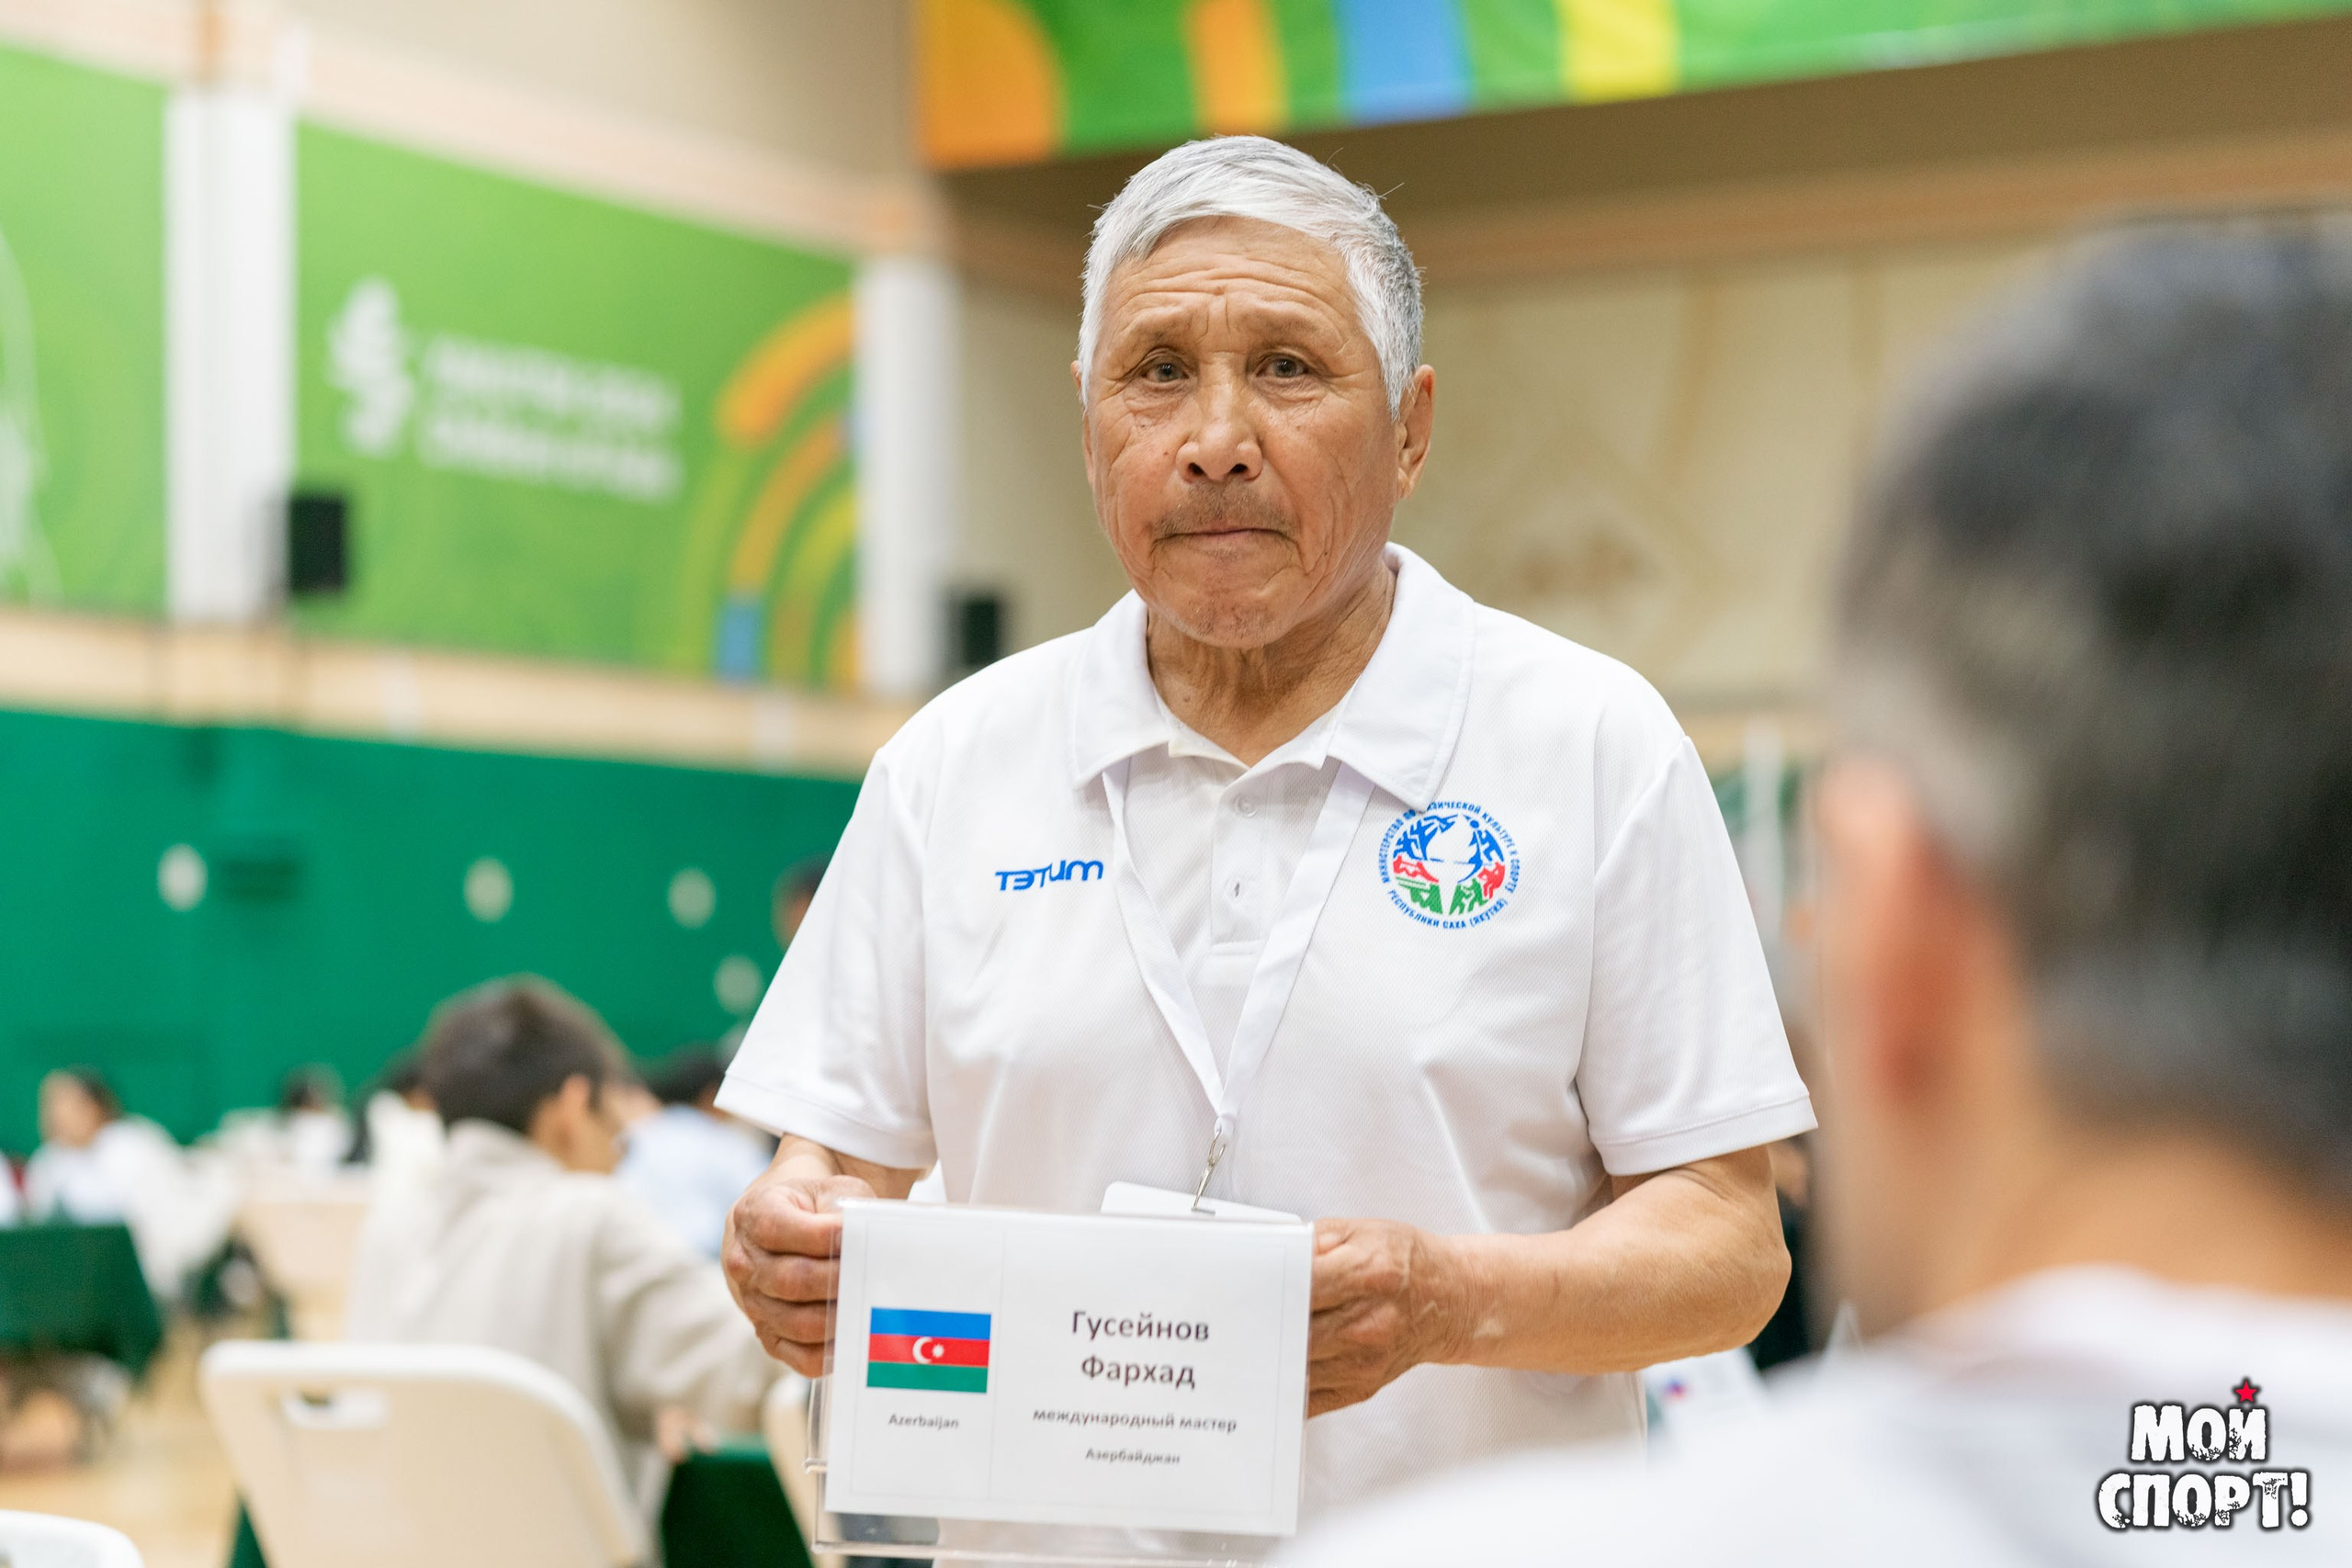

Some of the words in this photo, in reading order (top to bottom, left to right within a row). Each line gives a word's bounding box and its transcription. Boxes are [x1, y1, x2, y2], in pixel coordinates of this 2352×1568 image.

[1387, 889, 1440, 928] РЕСПУБЛИКИ
[1442, 919, 1466, 930] САХА
[1470, 897, 1509, 928] (ЯКУТИЯ)
[1071, 1310, 1210, 1342] Гусейнов
[1080, 1355, 1196, 1390] Фархад
[888, 1413, 959, 1430] Azerbaijan
[1033, 1408, 1175, 1429] международный
[1179, 1416, 1238, 1434] мастер
[1085, 1447, 1181, 1465] Азербайджан
